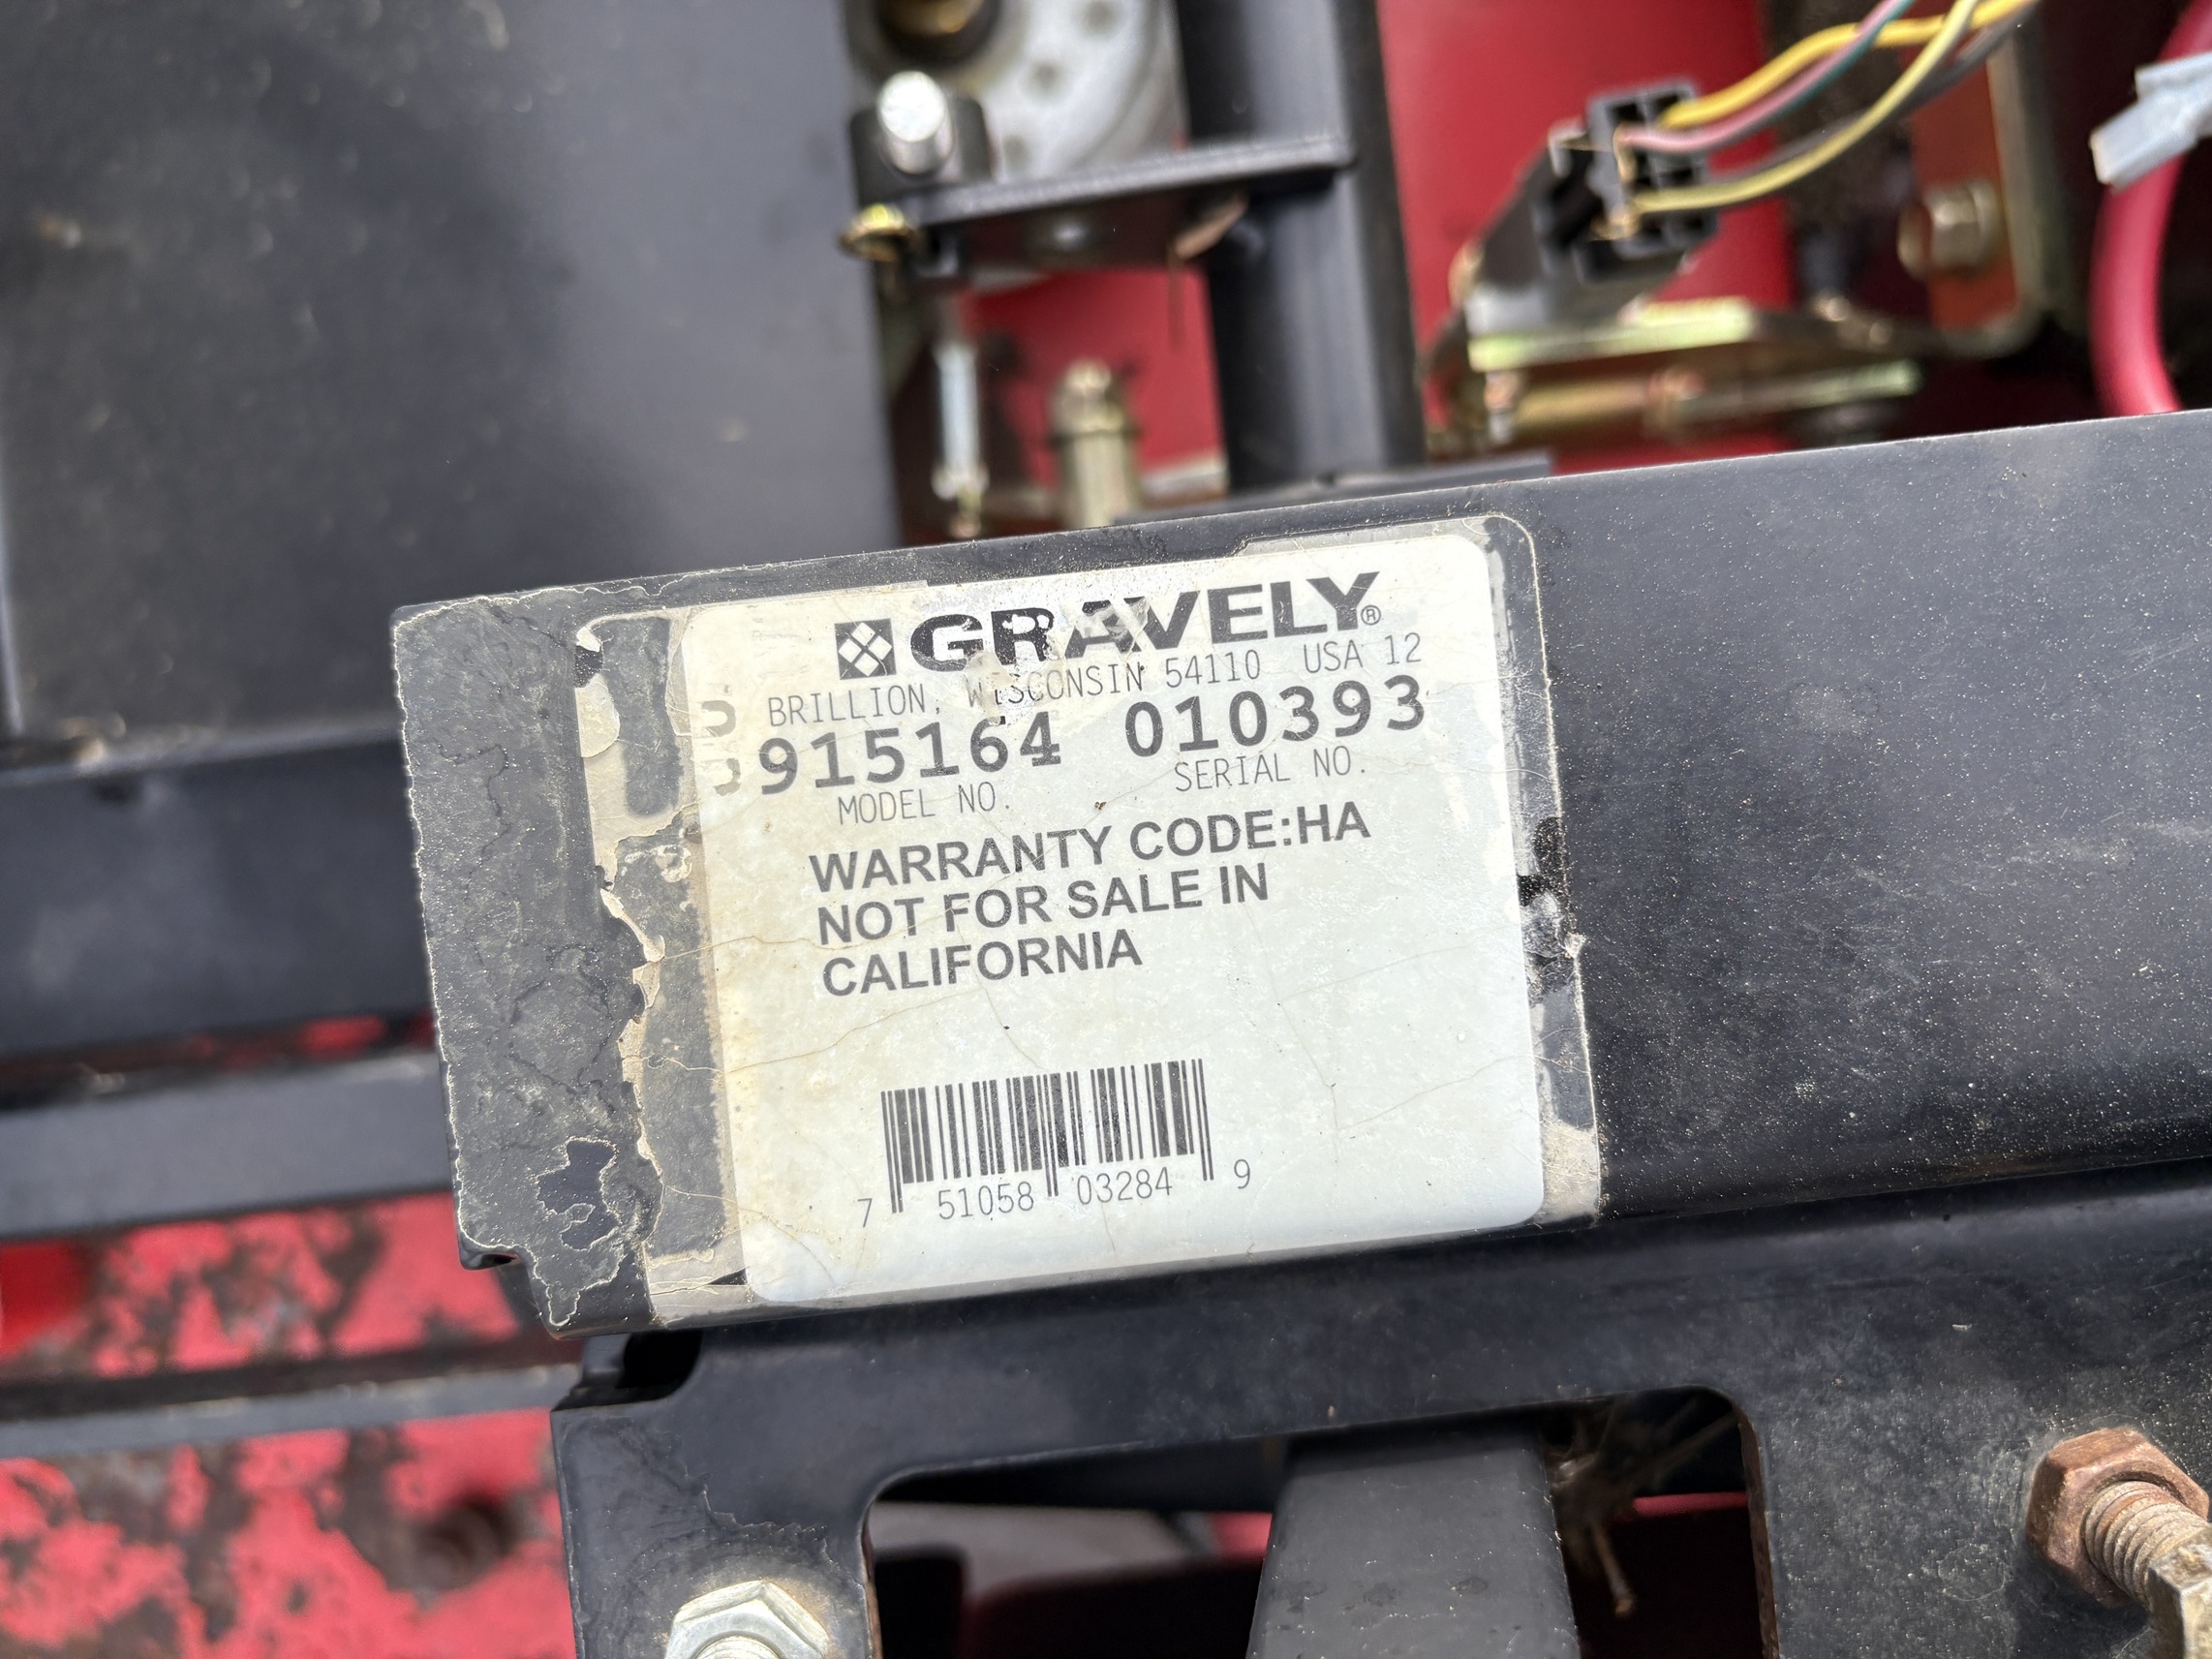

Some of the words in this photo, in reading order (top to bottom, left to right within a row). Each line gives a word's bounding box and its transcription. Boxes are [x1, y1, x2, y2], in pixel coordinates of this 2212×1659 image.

[909, 571, 1380, 672] GRAVELY
[1165, 649, 1261, 689] 54110
[1304, 638, 1364, 674] USA
[1384, 631, 1423, 665] 12
[757, 711, 1062, 796] 915164
[1124, 674, 1426, 758] 010393
[1174, 753, 1291, 792] SERIAL
[1313, 745, 1367, 779] NO.
[837, 788, 937, 826] MODEL
[958, 781, 1011, 814] NO.
[808, 825, 1113, 893] WARRANTY
[1129, 800, 1372, 860] CODE:HA
[817, 897, 925, 945] NOT
[943, 884, 1050, 933] FOR
[1067, 869, 1203, 919] SALE
[1219, 862, 1269, 906] IN
[822, 928, 1144, 998] CALIFORNIA
[857, 1197, 874, 1228] 7
[937, 1181, 1035, 1220] 51058
[1076, 1166, 1173, 1206] 03284
[1233, 1158, 1252, 1189] 9
